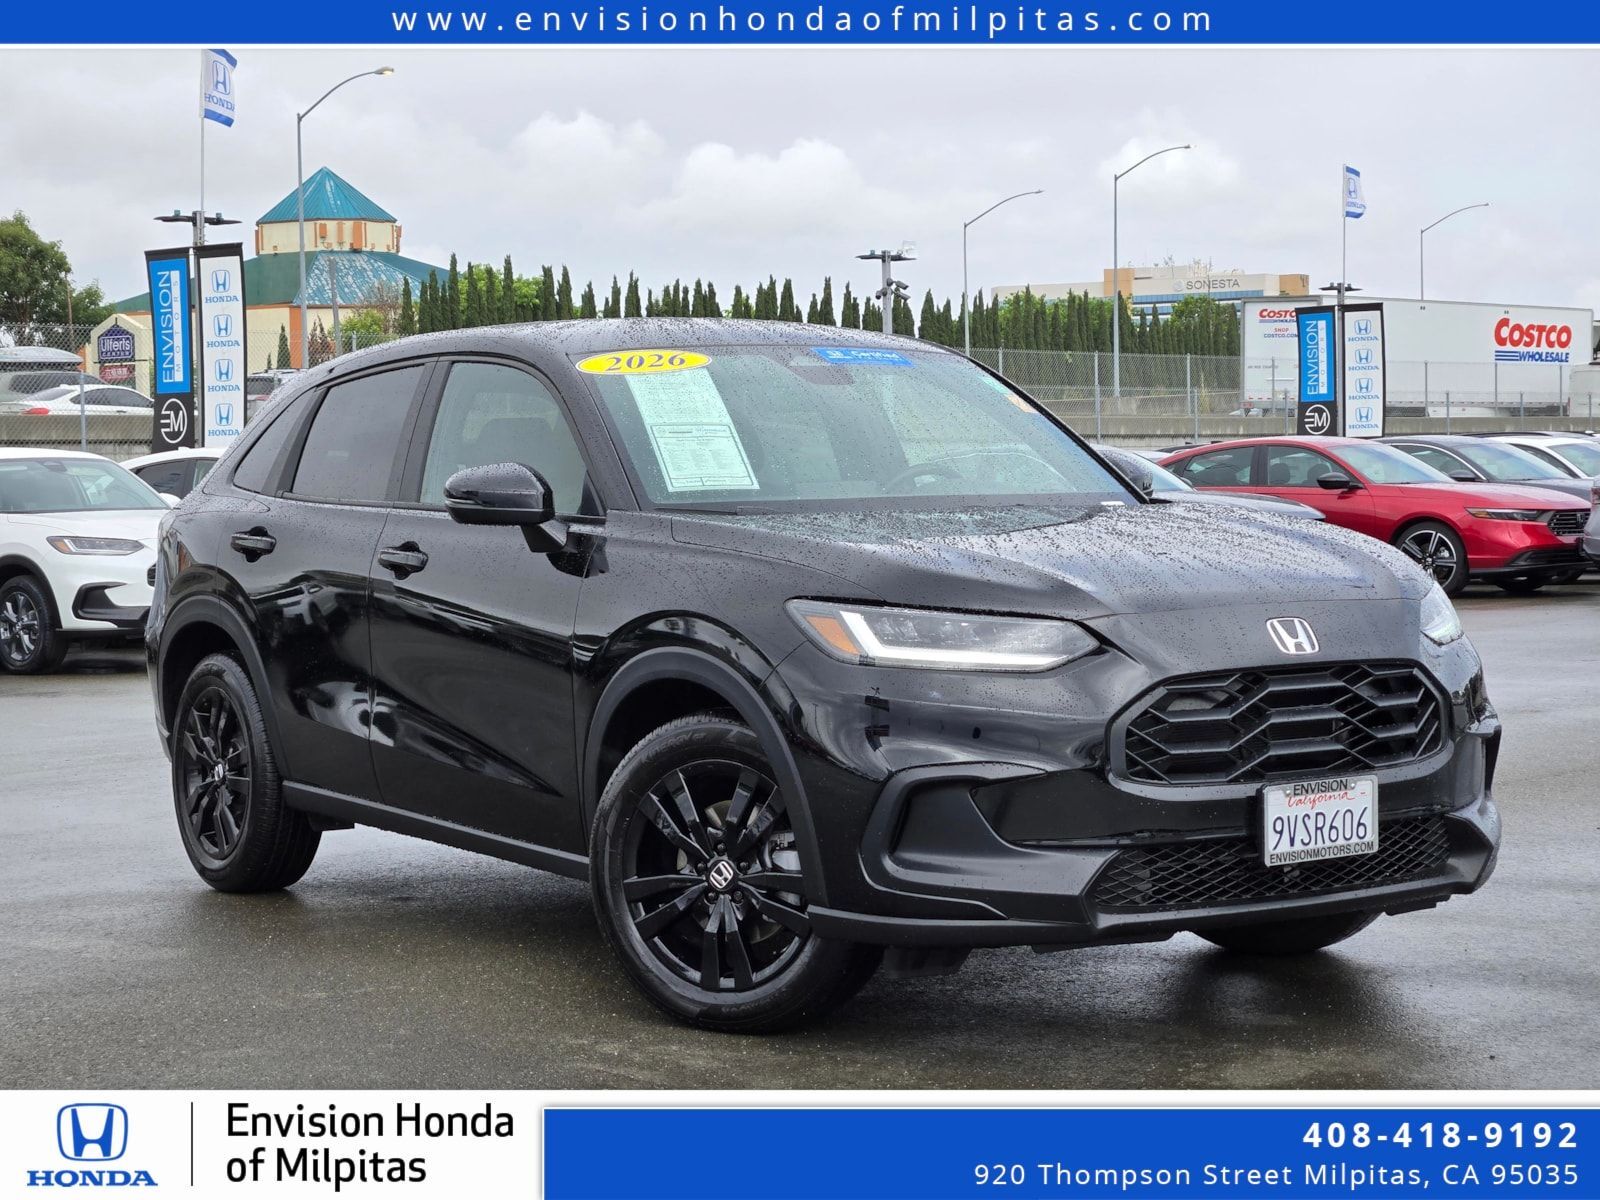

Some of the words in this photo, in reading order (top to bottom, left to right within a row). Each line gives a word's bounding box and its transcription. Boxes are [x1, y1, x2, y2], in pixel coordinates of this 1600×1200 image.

[1186, 279, 1241, 290] SONESTA
[205, 295, 239, 304] HONDA
[157, 270, 175, 383] ENVISION
[1494, 317, 1572, 349] COSTCO
[206, 339, 240, 348] HONDA
[606, 353, 686, 371] 2026
[1305, 320, 1319, 395] ENVISION
[1519, 351, 1570, 363] WHOLESALE
[207, 384, 240, 392] HONDA
[208, 429, 240, 437] HONDA
[1293, 779, 1348, 796] ENVISION
[1287, 791, 1355, 810] California
[1272, 806, 1368, 851] 9VSR606
[1269, 841, 1374, 865] ENVISIONMOTORS.COM
